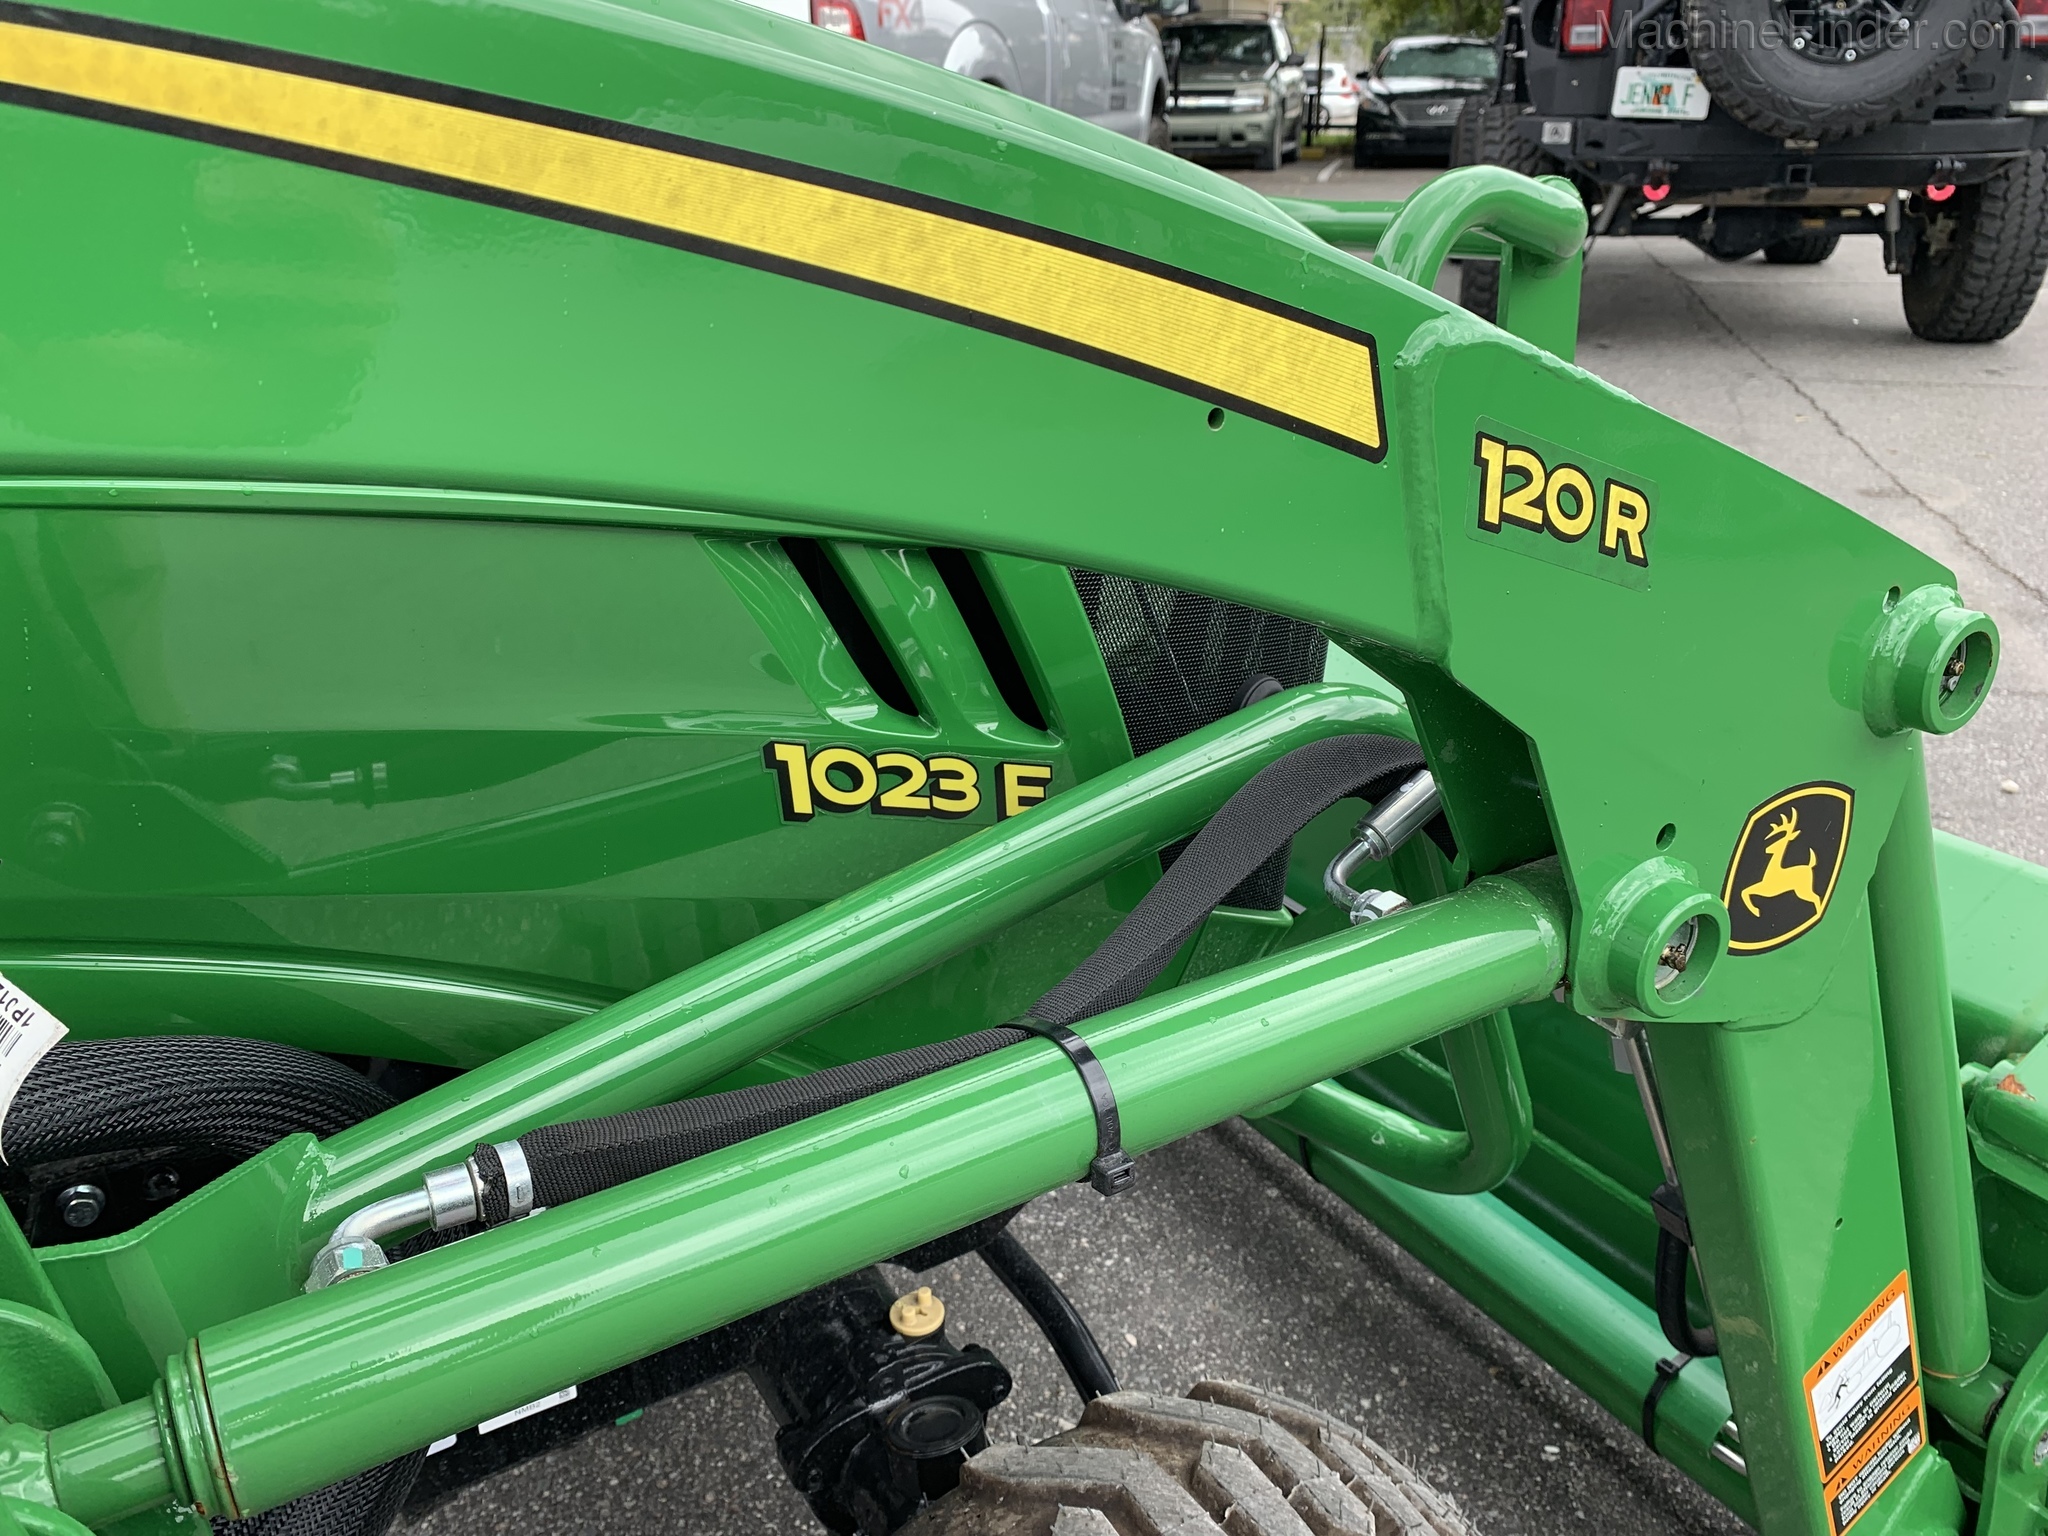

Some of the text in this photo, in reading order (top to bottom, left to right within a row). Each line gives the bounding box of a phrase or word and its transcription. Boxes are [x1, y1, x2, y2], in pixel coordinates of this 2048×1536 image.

[877, 0, 925, 29] FX4
[1474, 431, 1649, 568] 120 R
[763, 740, 1052, 823] 1023 E
[1833, 1289, 1895, 1357] WARNING
[1852, 1404, 1911, 1470] WARNING
